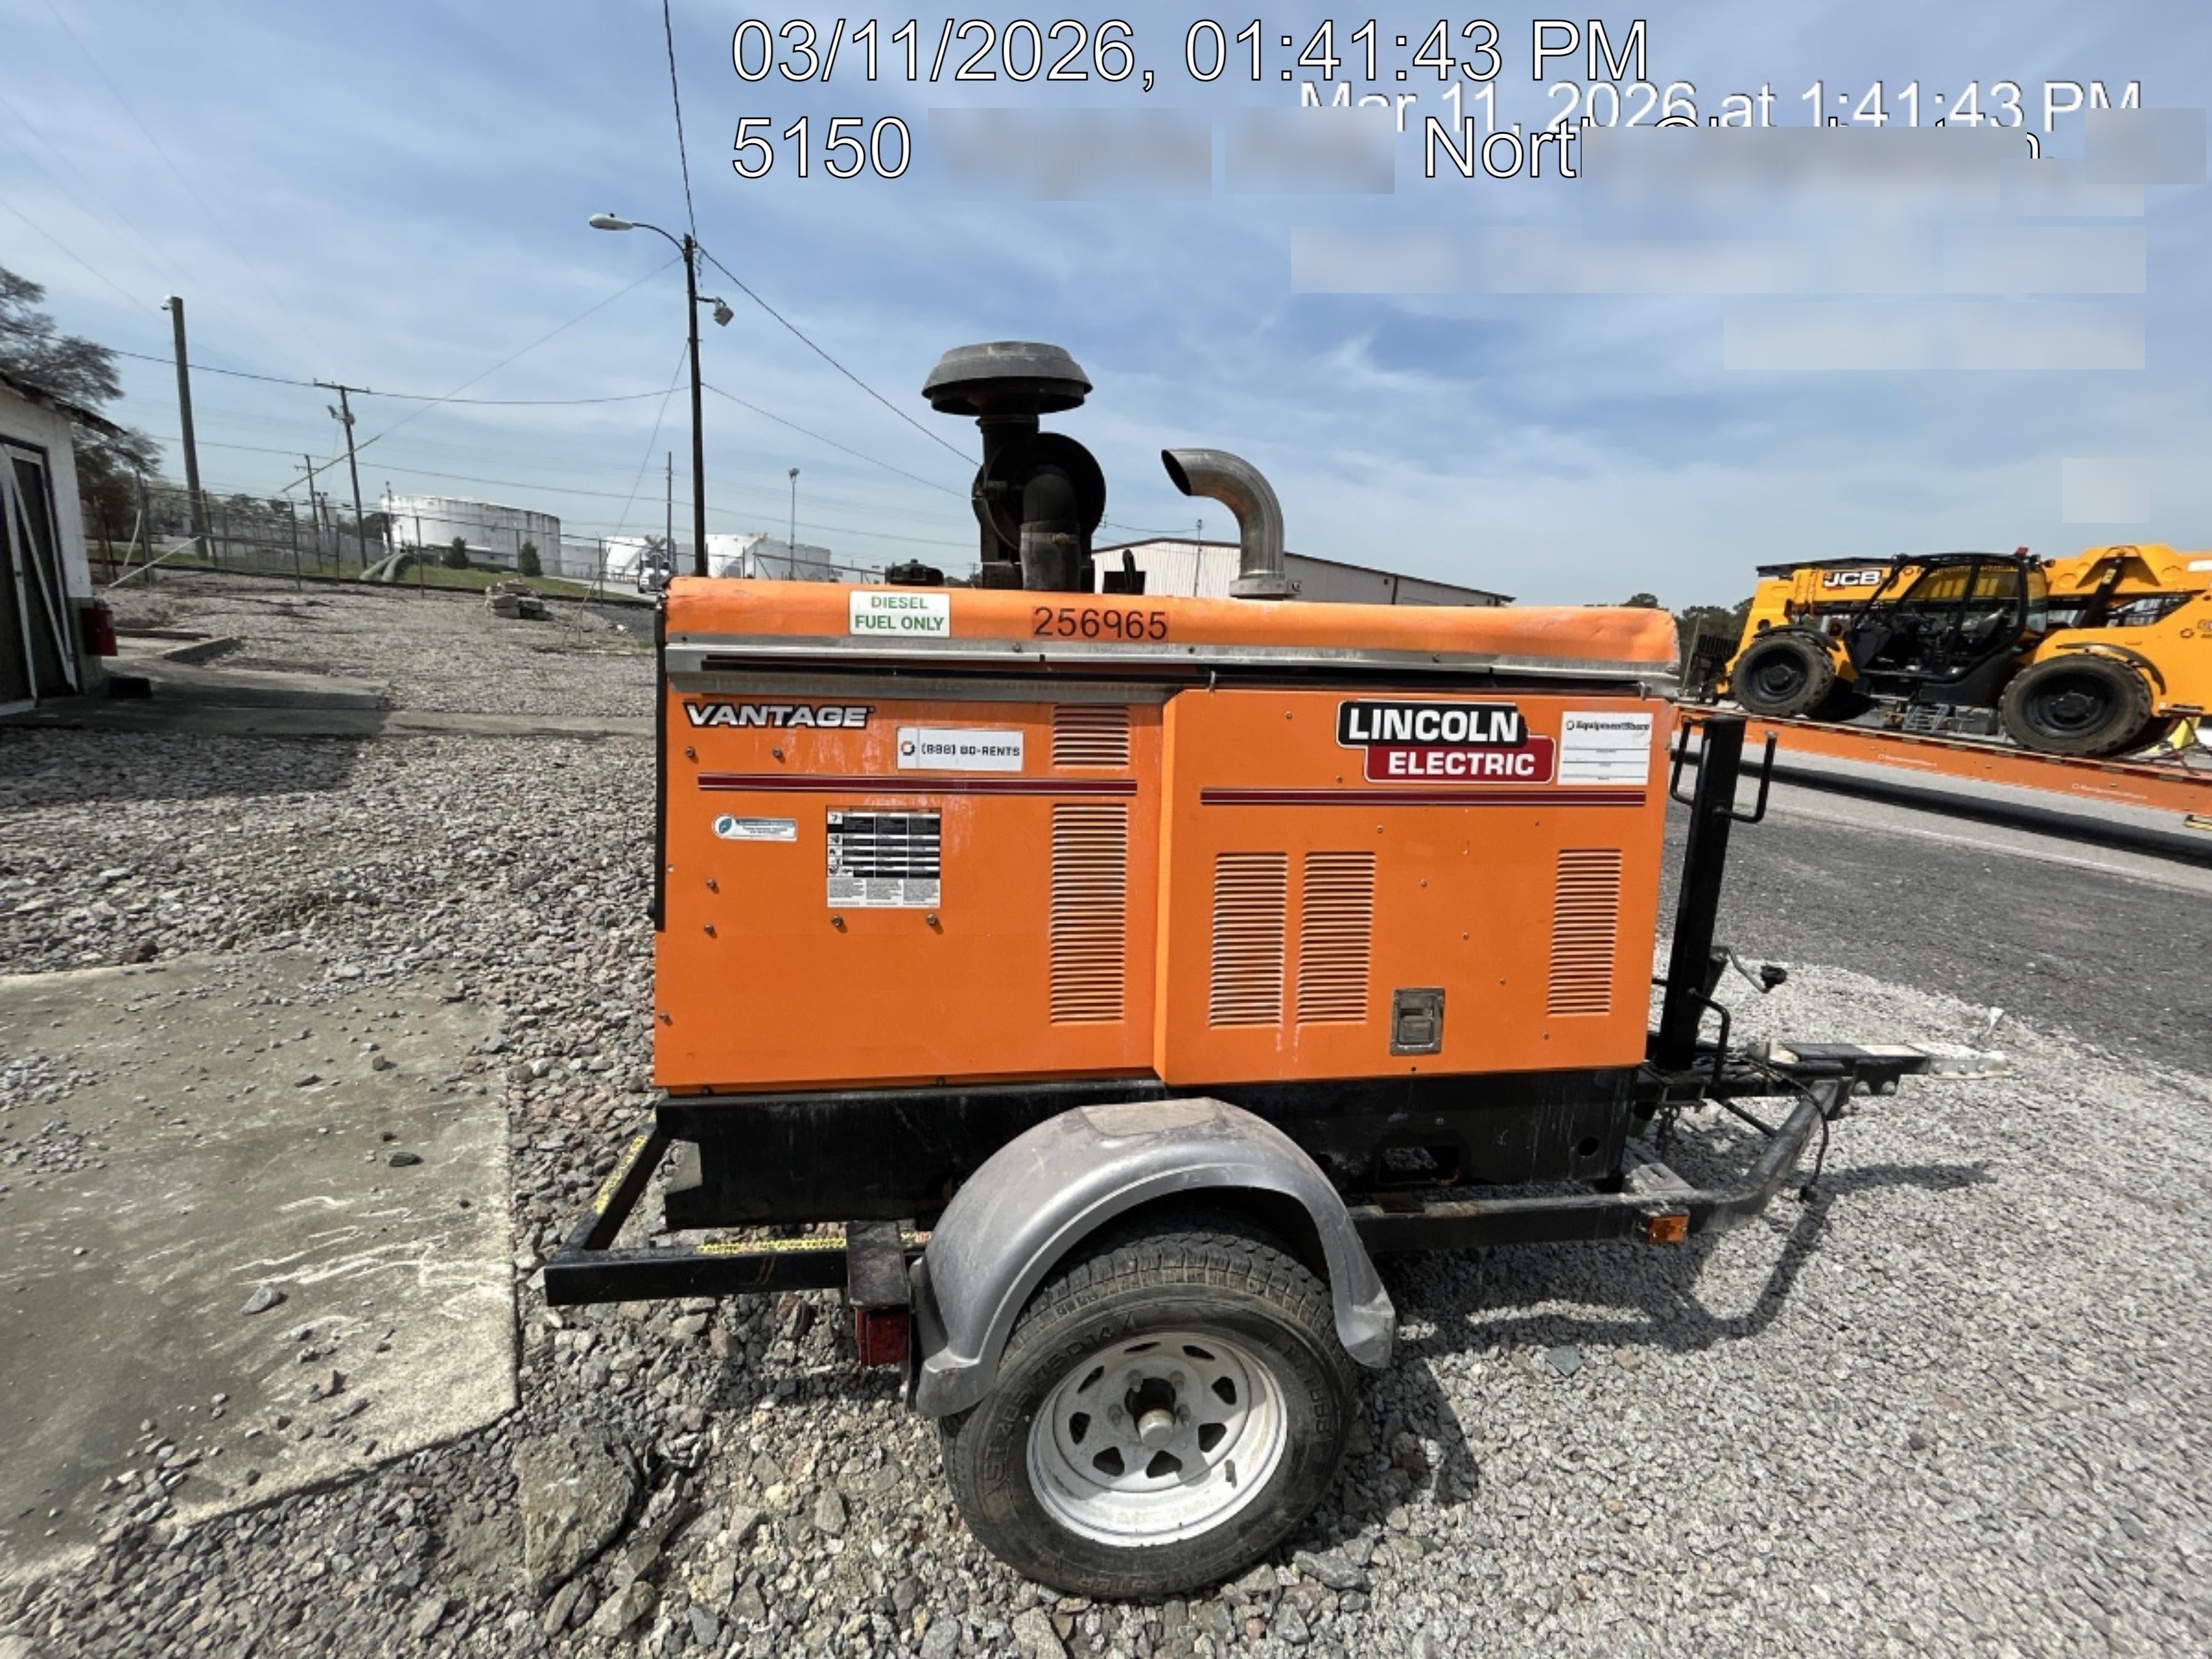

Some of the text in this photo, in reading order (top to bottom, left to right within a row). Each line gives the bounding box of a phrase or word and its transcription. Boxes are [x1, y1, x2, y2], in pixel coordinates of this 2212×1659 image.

[1822, 571, 1880, 586] JCB
[870, 595, 928, 610] DIESEL
[855, 614, 944, 631] FUEL ONLY
[1033, 606, 1167, 640] 256965
[684, 704, 869, 727] VANTAGE
[1349, 708, 1519, 742] LINCOLN
[1387, 751, 1535, 775] ELECTRIC
